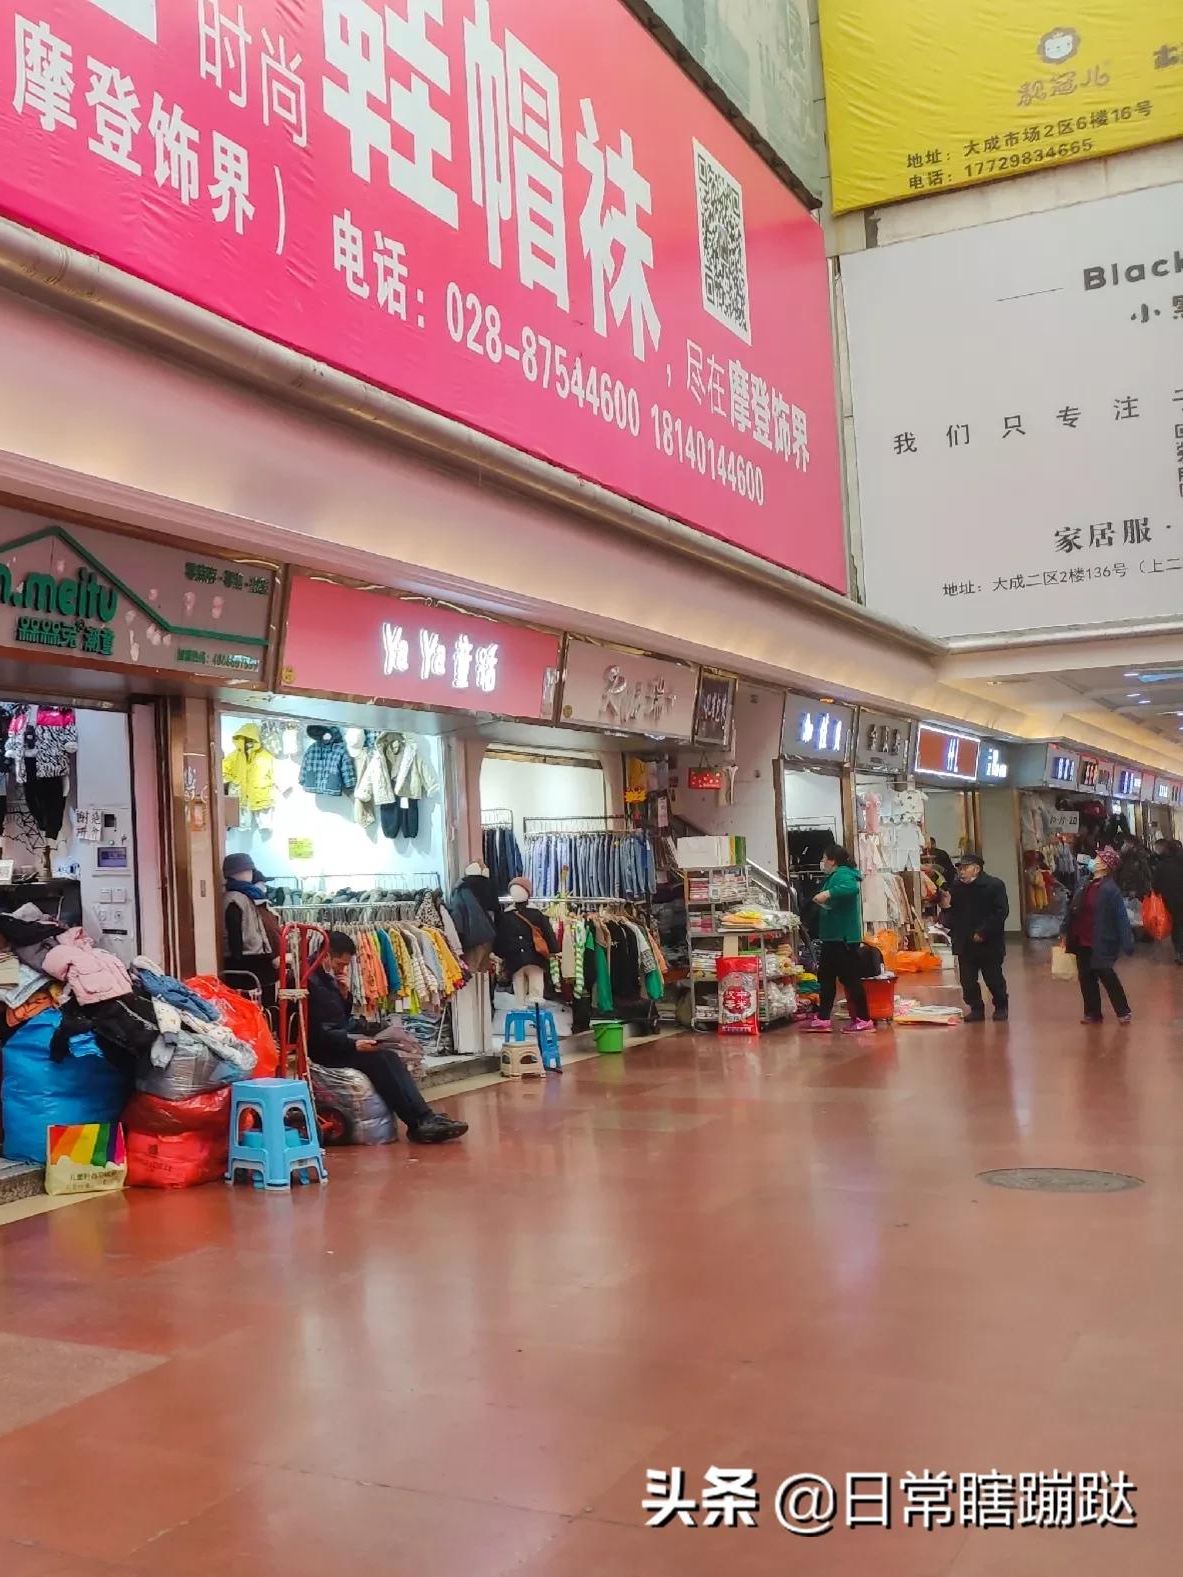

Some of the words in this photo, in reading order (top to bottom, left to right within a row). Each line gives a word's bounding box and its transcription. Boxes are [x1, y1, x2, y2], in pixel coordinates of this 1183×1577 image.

[321, 0, 661, 361] 鞋帽袜
[964, 137, 1094, 178] 17729834665
[445, 281, 640, 437] 028-87544600
[650, 403, 764, 507] 18140144600
